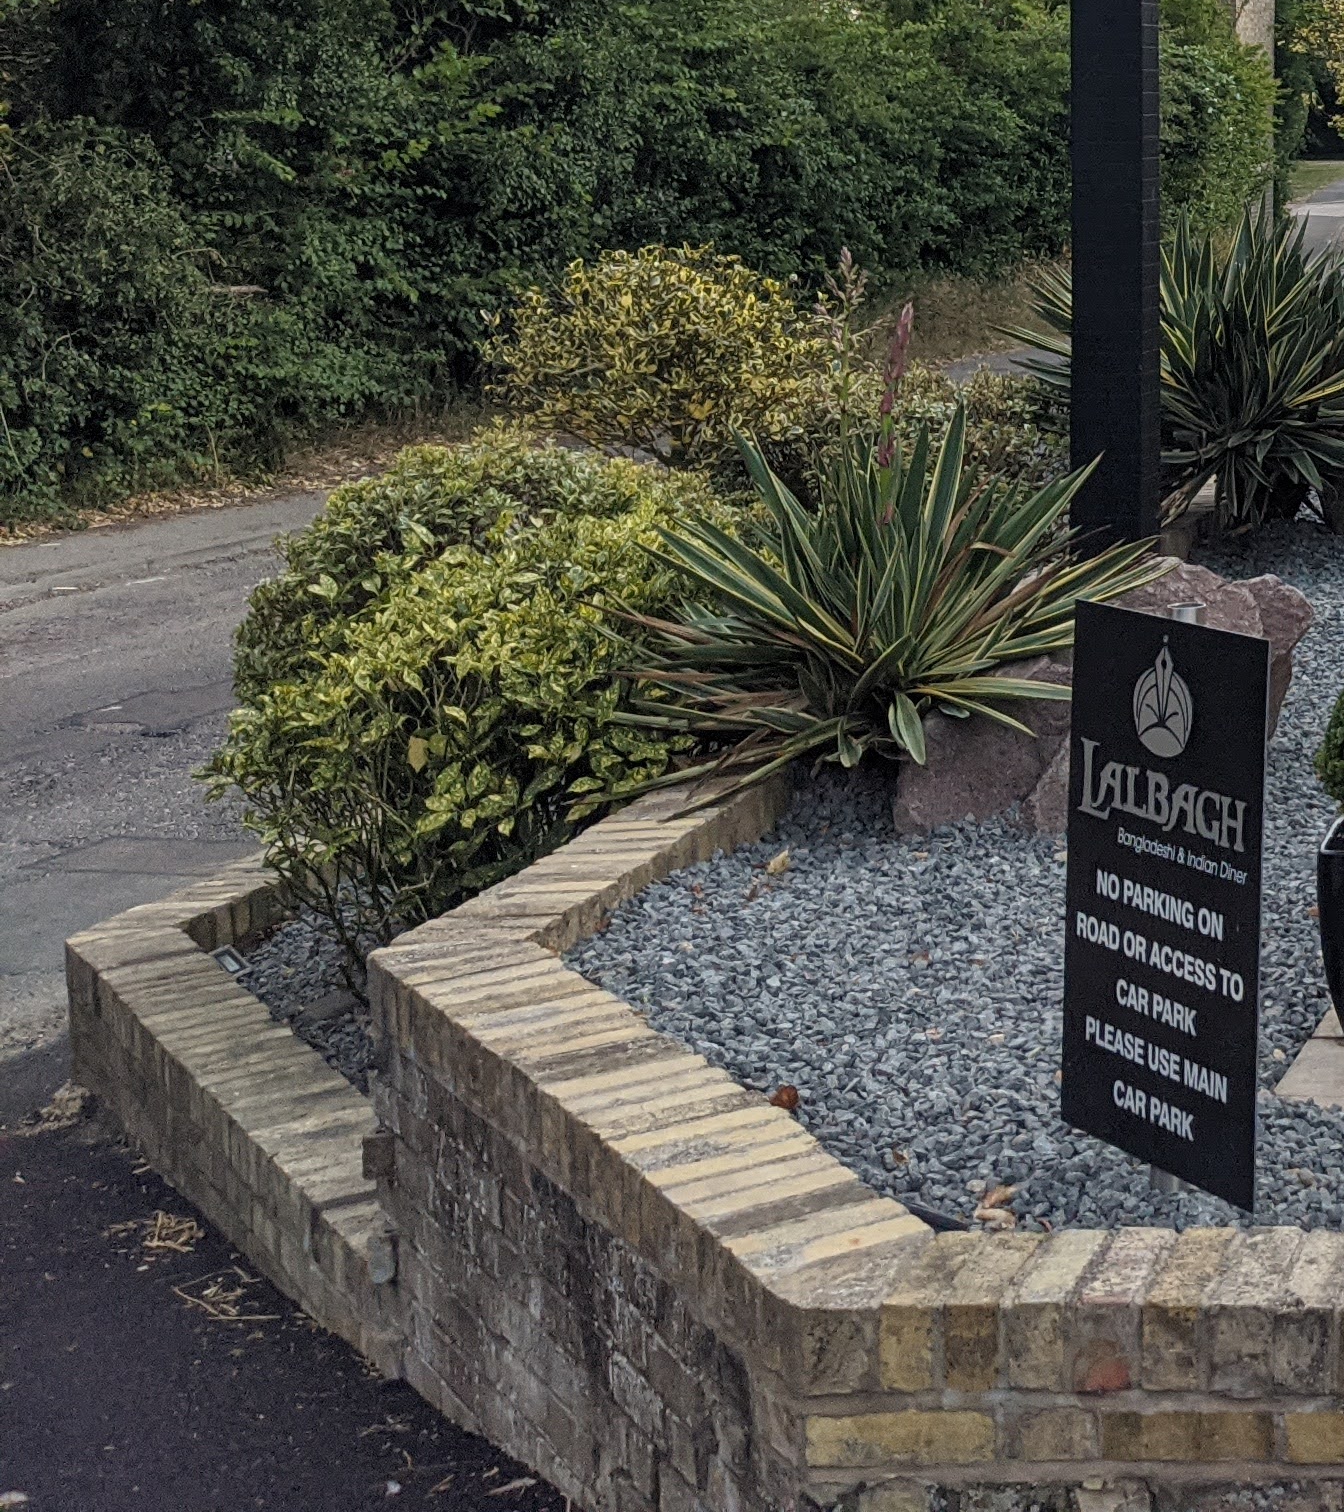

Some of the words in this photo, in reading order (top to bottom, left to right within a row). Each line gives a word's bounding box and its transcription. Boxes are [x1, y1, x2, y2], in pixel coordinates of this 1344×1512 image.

[1077, 737, 1248, 852] LALBAGH
[1117, 827, 1176, 861] Bangladeshi
[1177, 847, 1185, 864] &
[1188, 850, 1217, 875] Indian
[1220, 861, 1248, 885] Diner
[1096, 868, 1120, 900] NO
[1123, 879, 1194, 930] PARKING
[1198, 907, 1224, 941] ON
[1076, 911, 1120, 951] ROAD
[1123, 930, 1147, 963] OR
[1149, 941, 1217, 991] ACCESS
[1219, 967, 1244, 1002] TO
[1116, 978, 1149, 1016] CAR
[1152, 992, 1197, 1037] PARK
[1085, 1015, 1145, 1066] PLEASE
[1148, 1042, 1180, 1082] USE
[1184, 1058, 1228, 1104] MAIN
[1113, 1079, 1147, 1120] CAR
[1150, 1096, 1194, 1142] PARK
